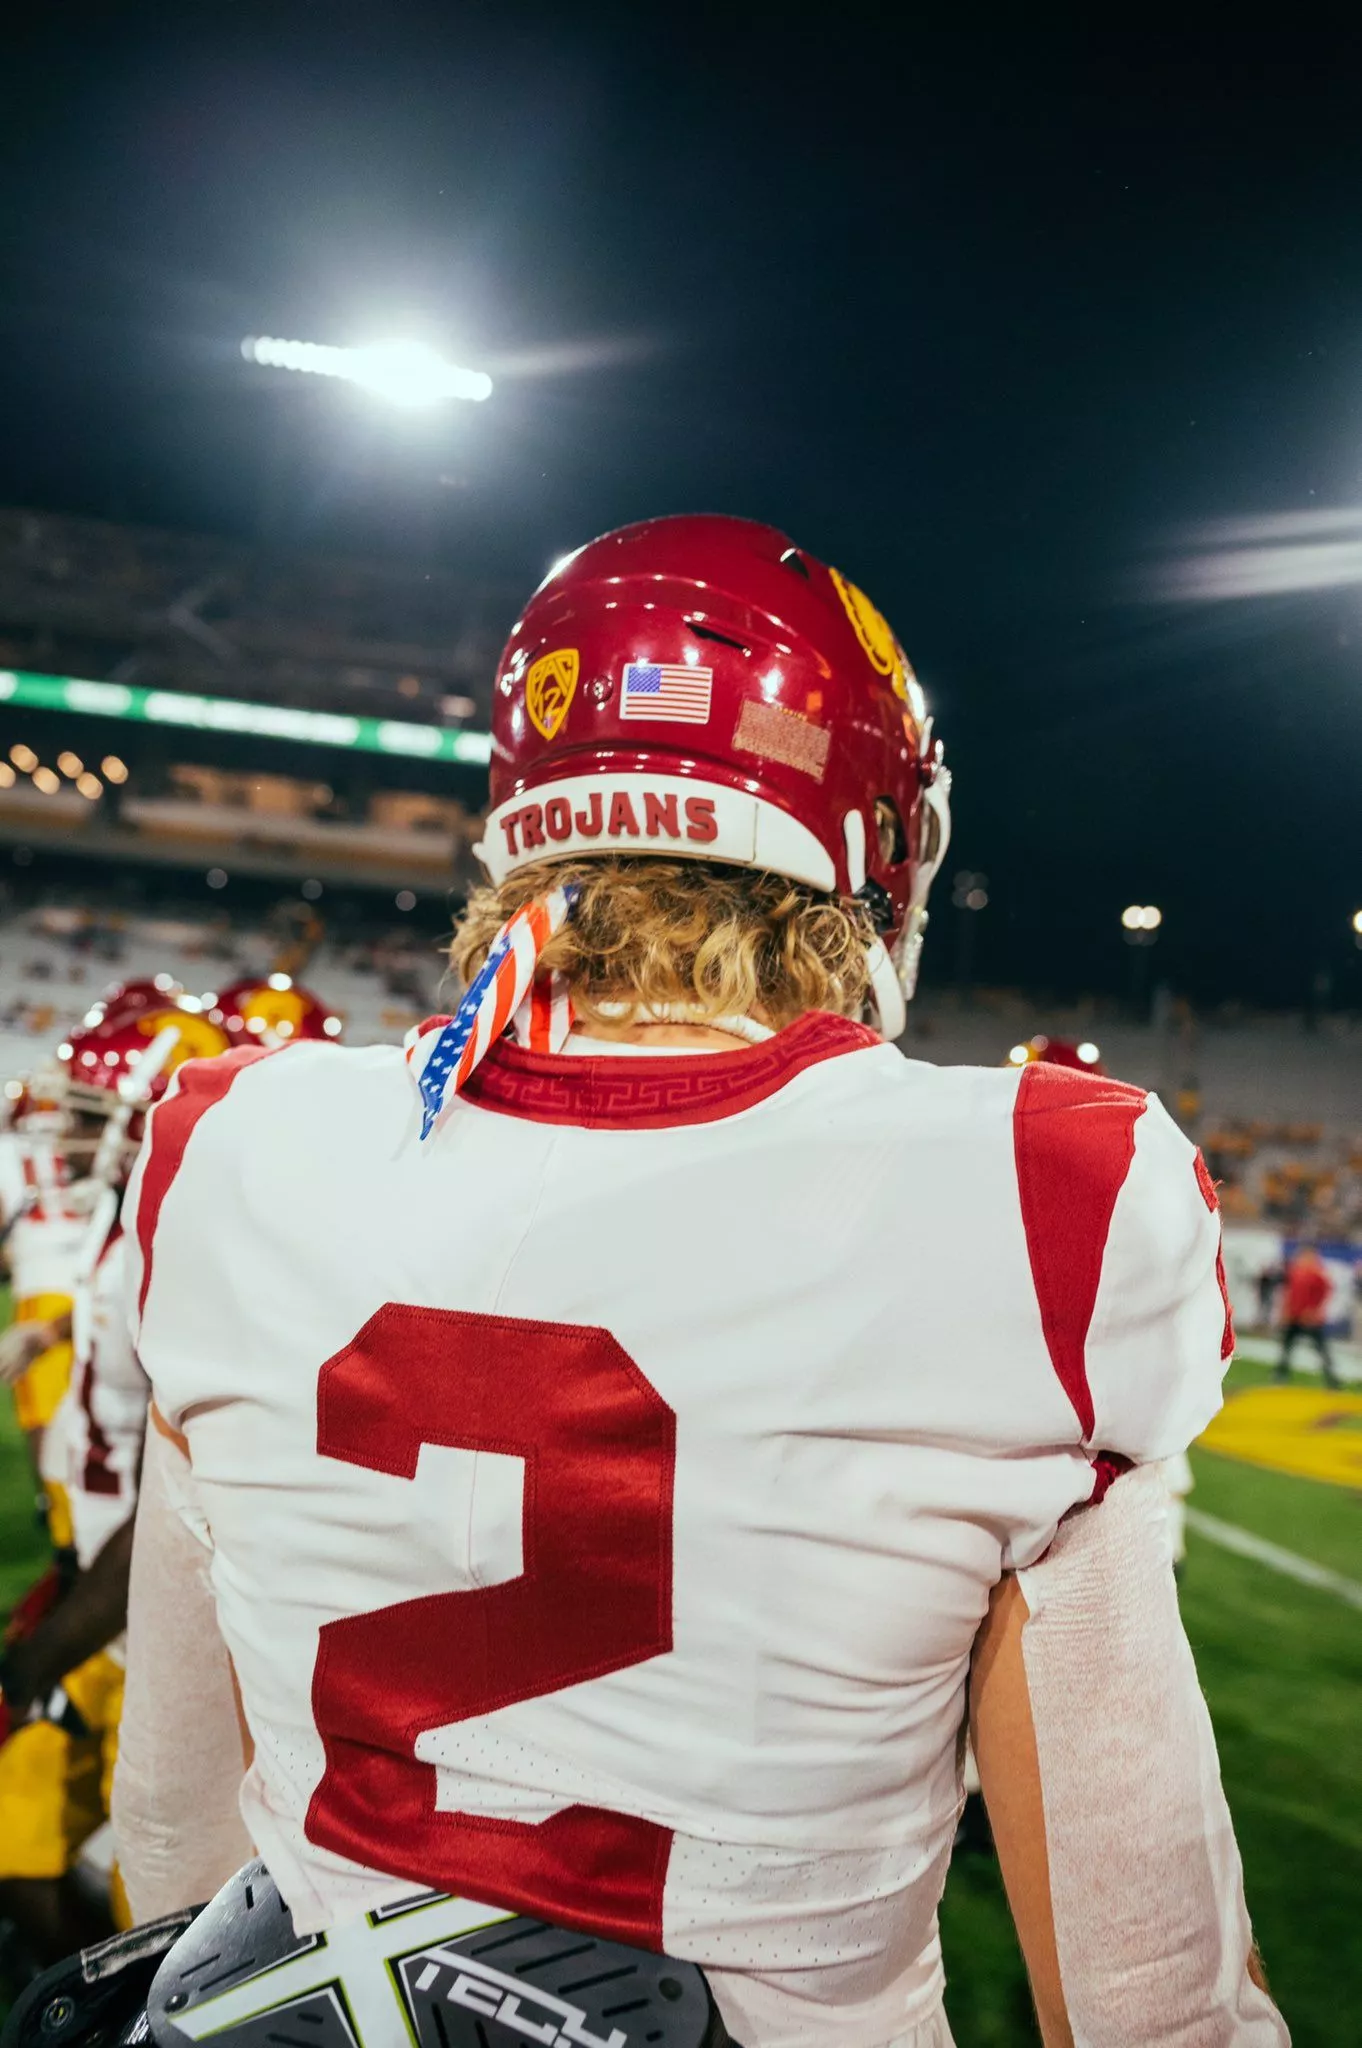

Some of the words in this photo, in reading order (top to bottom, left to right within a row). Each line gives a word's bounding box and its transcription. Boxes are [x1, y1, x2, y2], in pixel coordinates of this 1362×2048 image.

[536, 687, 563, 720] 12
[500, 791, 719, 855] TROJANS
[305, 1302, 676, 1953] 2
